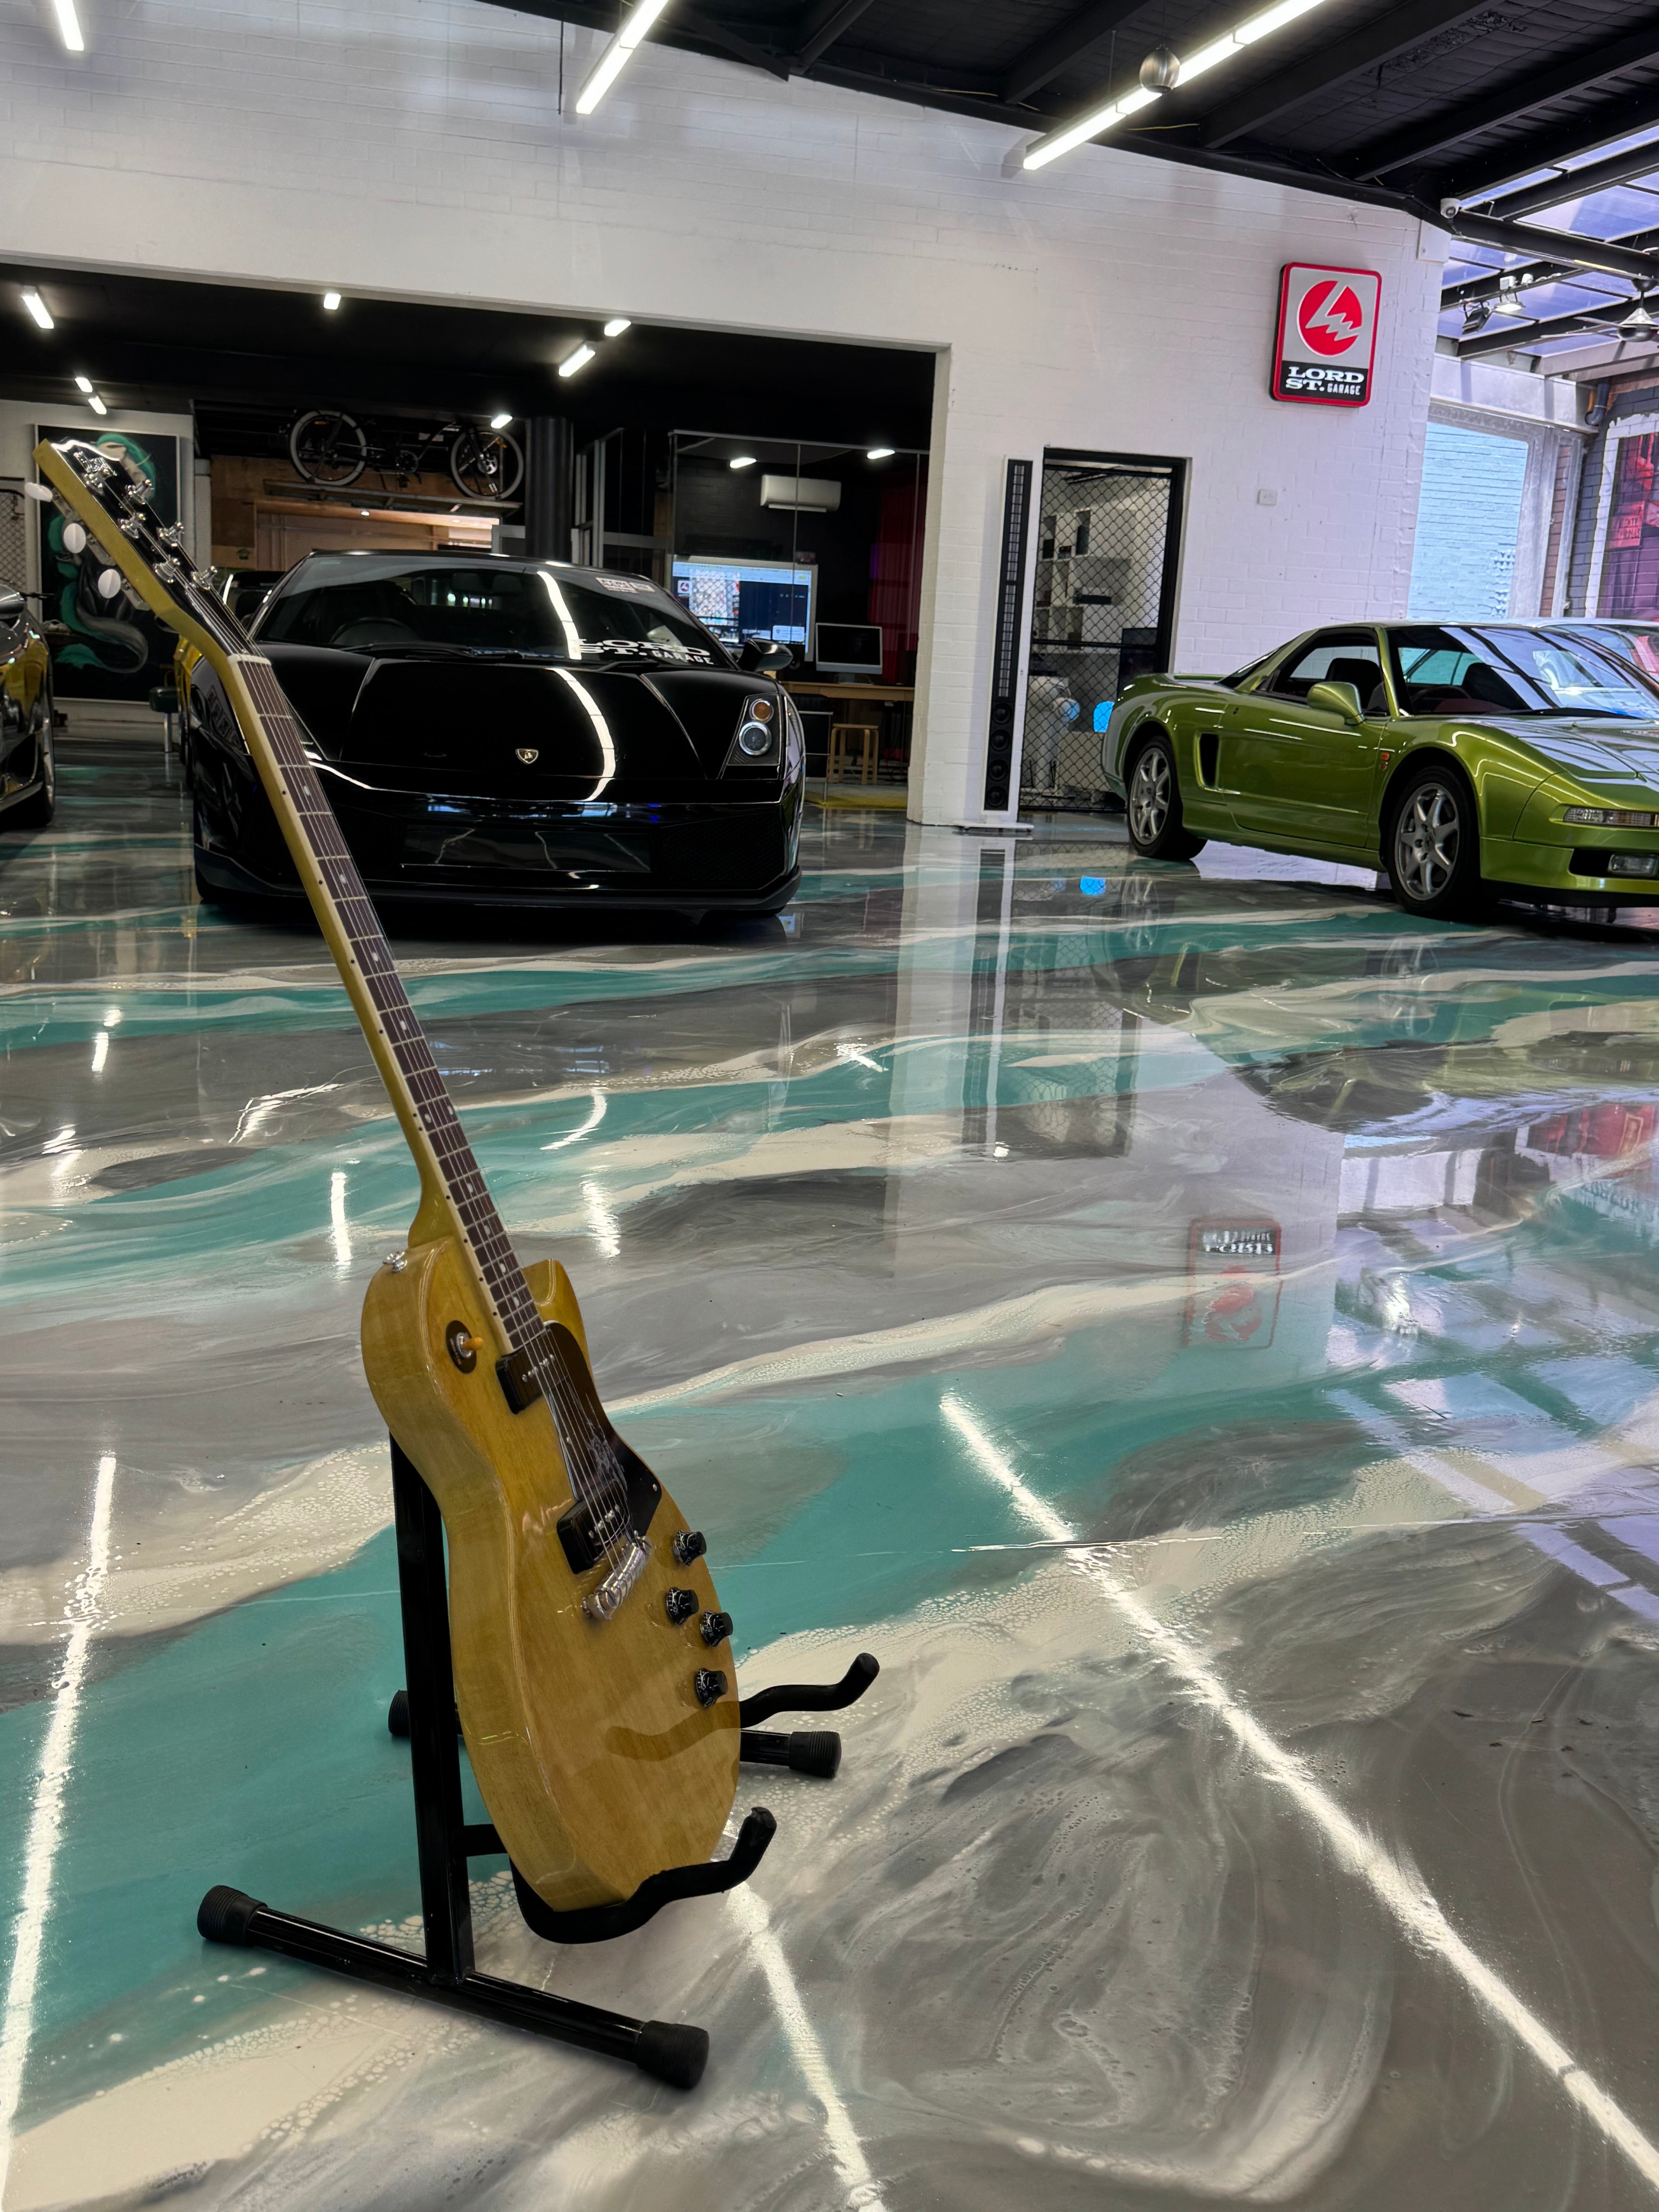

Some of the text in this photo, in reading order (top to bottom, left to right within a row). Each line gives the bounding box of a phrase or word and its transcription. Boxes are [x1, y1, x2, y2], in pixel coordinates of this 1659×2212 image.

[1289, 367, 1364, 383] LORD
[1286, 378, 1361, 395] ST. GARAGE
[570, 639, 710, 656] LORD
[652, 651, 714, 665] GARAGE
